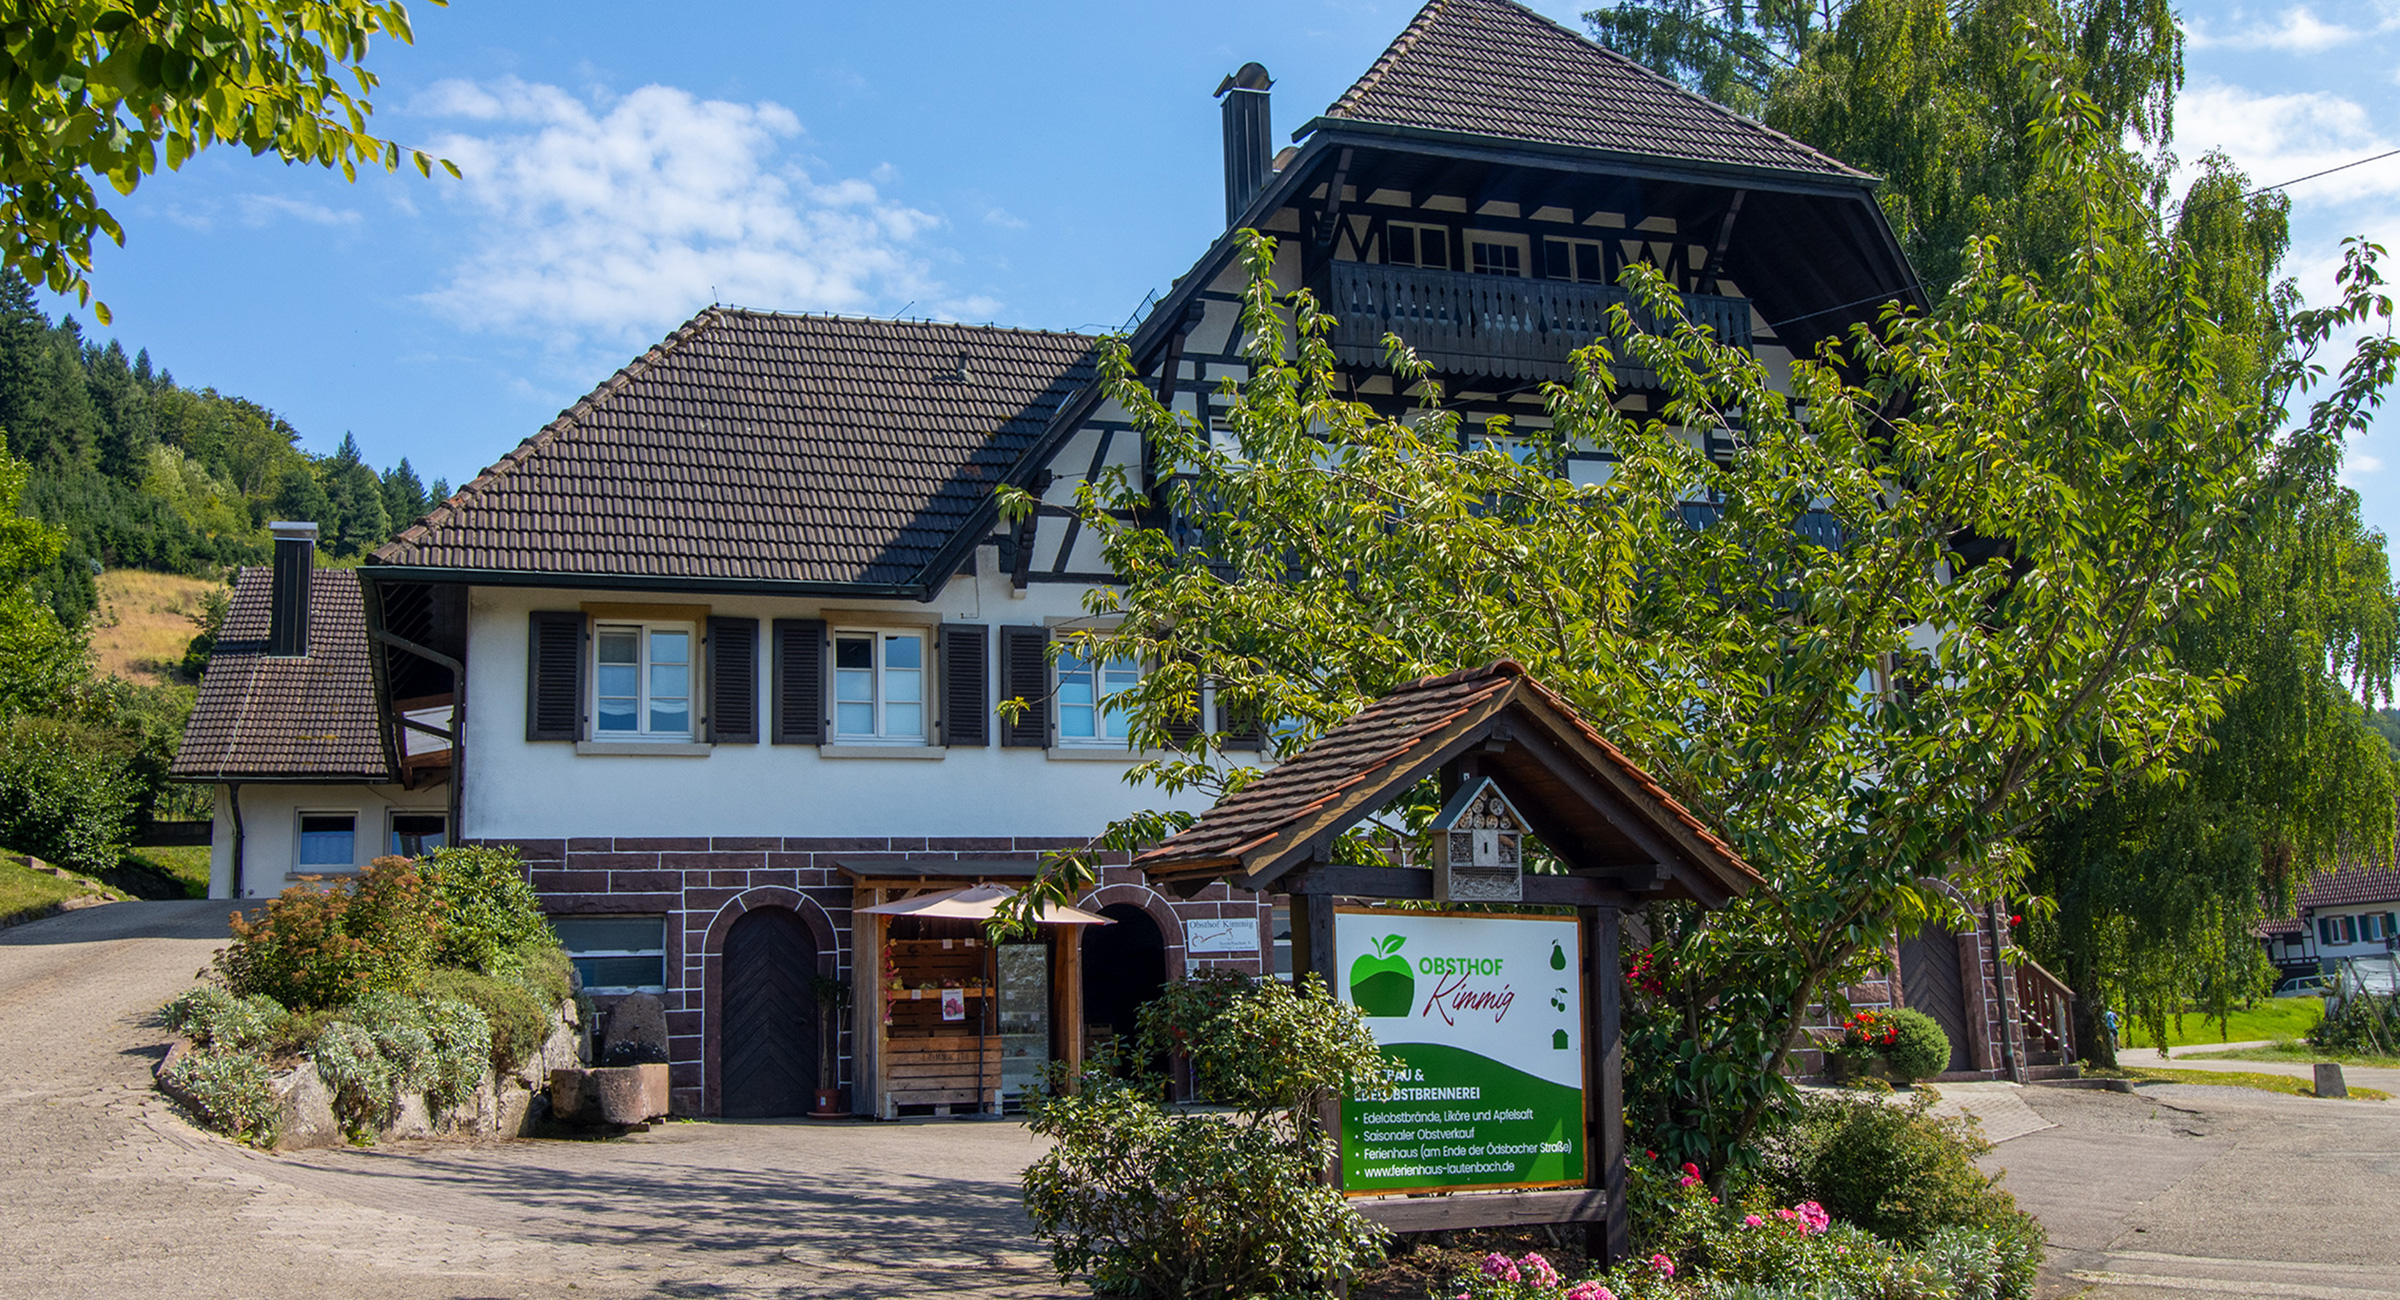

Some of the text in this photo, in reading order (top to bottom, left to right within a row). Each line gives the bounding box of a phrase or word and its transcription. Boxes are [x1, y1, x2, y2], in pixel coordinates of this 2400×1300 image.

[1189, 919, 1254, 929] Obsthof Kimmig
[1419, 957, 1503, 976] OBSTHOF
[1422, 969, 1516, 1027] Kimmig
[1363, 1108, 1534, 1125] Edelobstbrände, Liköre und Apfelsaft
[1363, 1127, 1475, 1142] Saisonaler Obstverkauf
[1364, 1138, 1573, 1160] Ferienhaus (am Ende der Ödsbacher Straße)
[1364, 1160, 1515, 1178] www.ferienhaus-lautenbach.de
